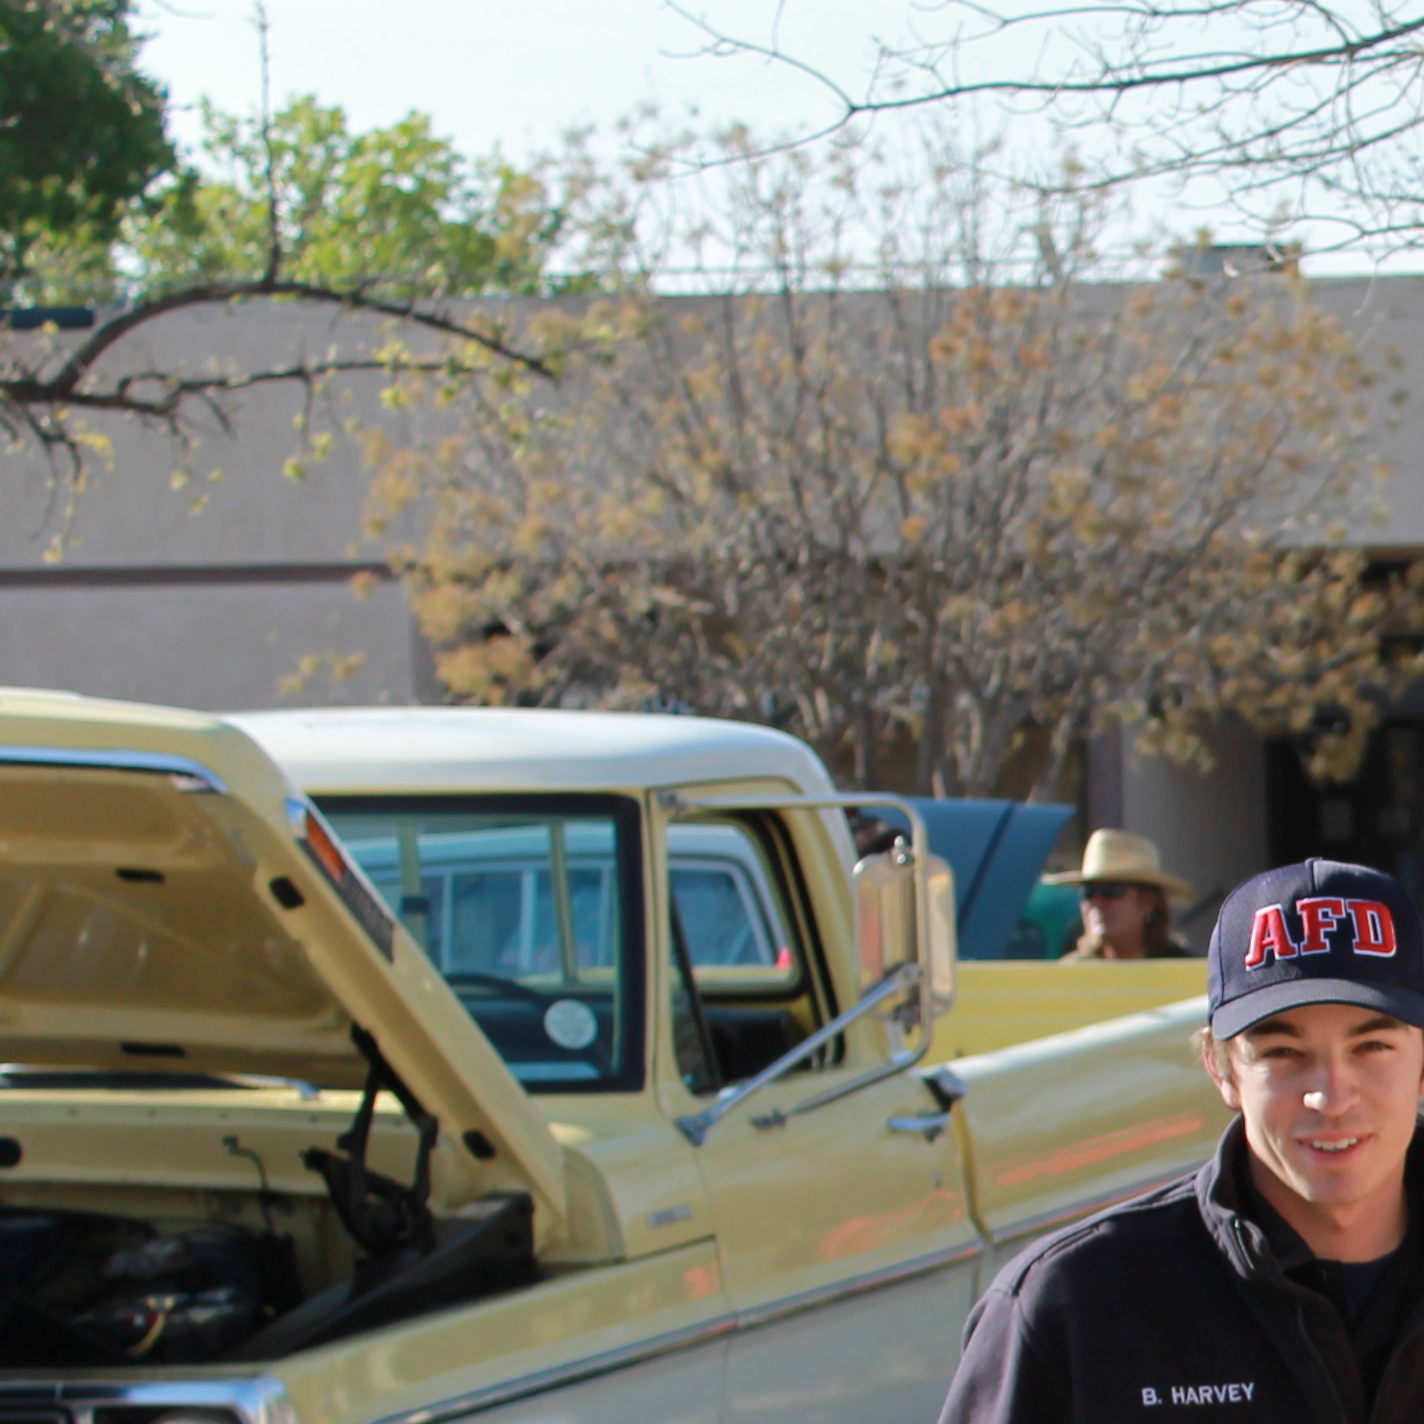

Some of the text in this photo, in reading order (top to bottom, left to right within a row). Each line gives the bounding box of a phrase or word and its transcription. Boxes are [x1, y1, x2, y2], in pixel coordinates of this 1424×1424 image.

[1244, 896, 1398, 971] AFD
[1141, 1382, 1255, 1406] B. HARVEY
